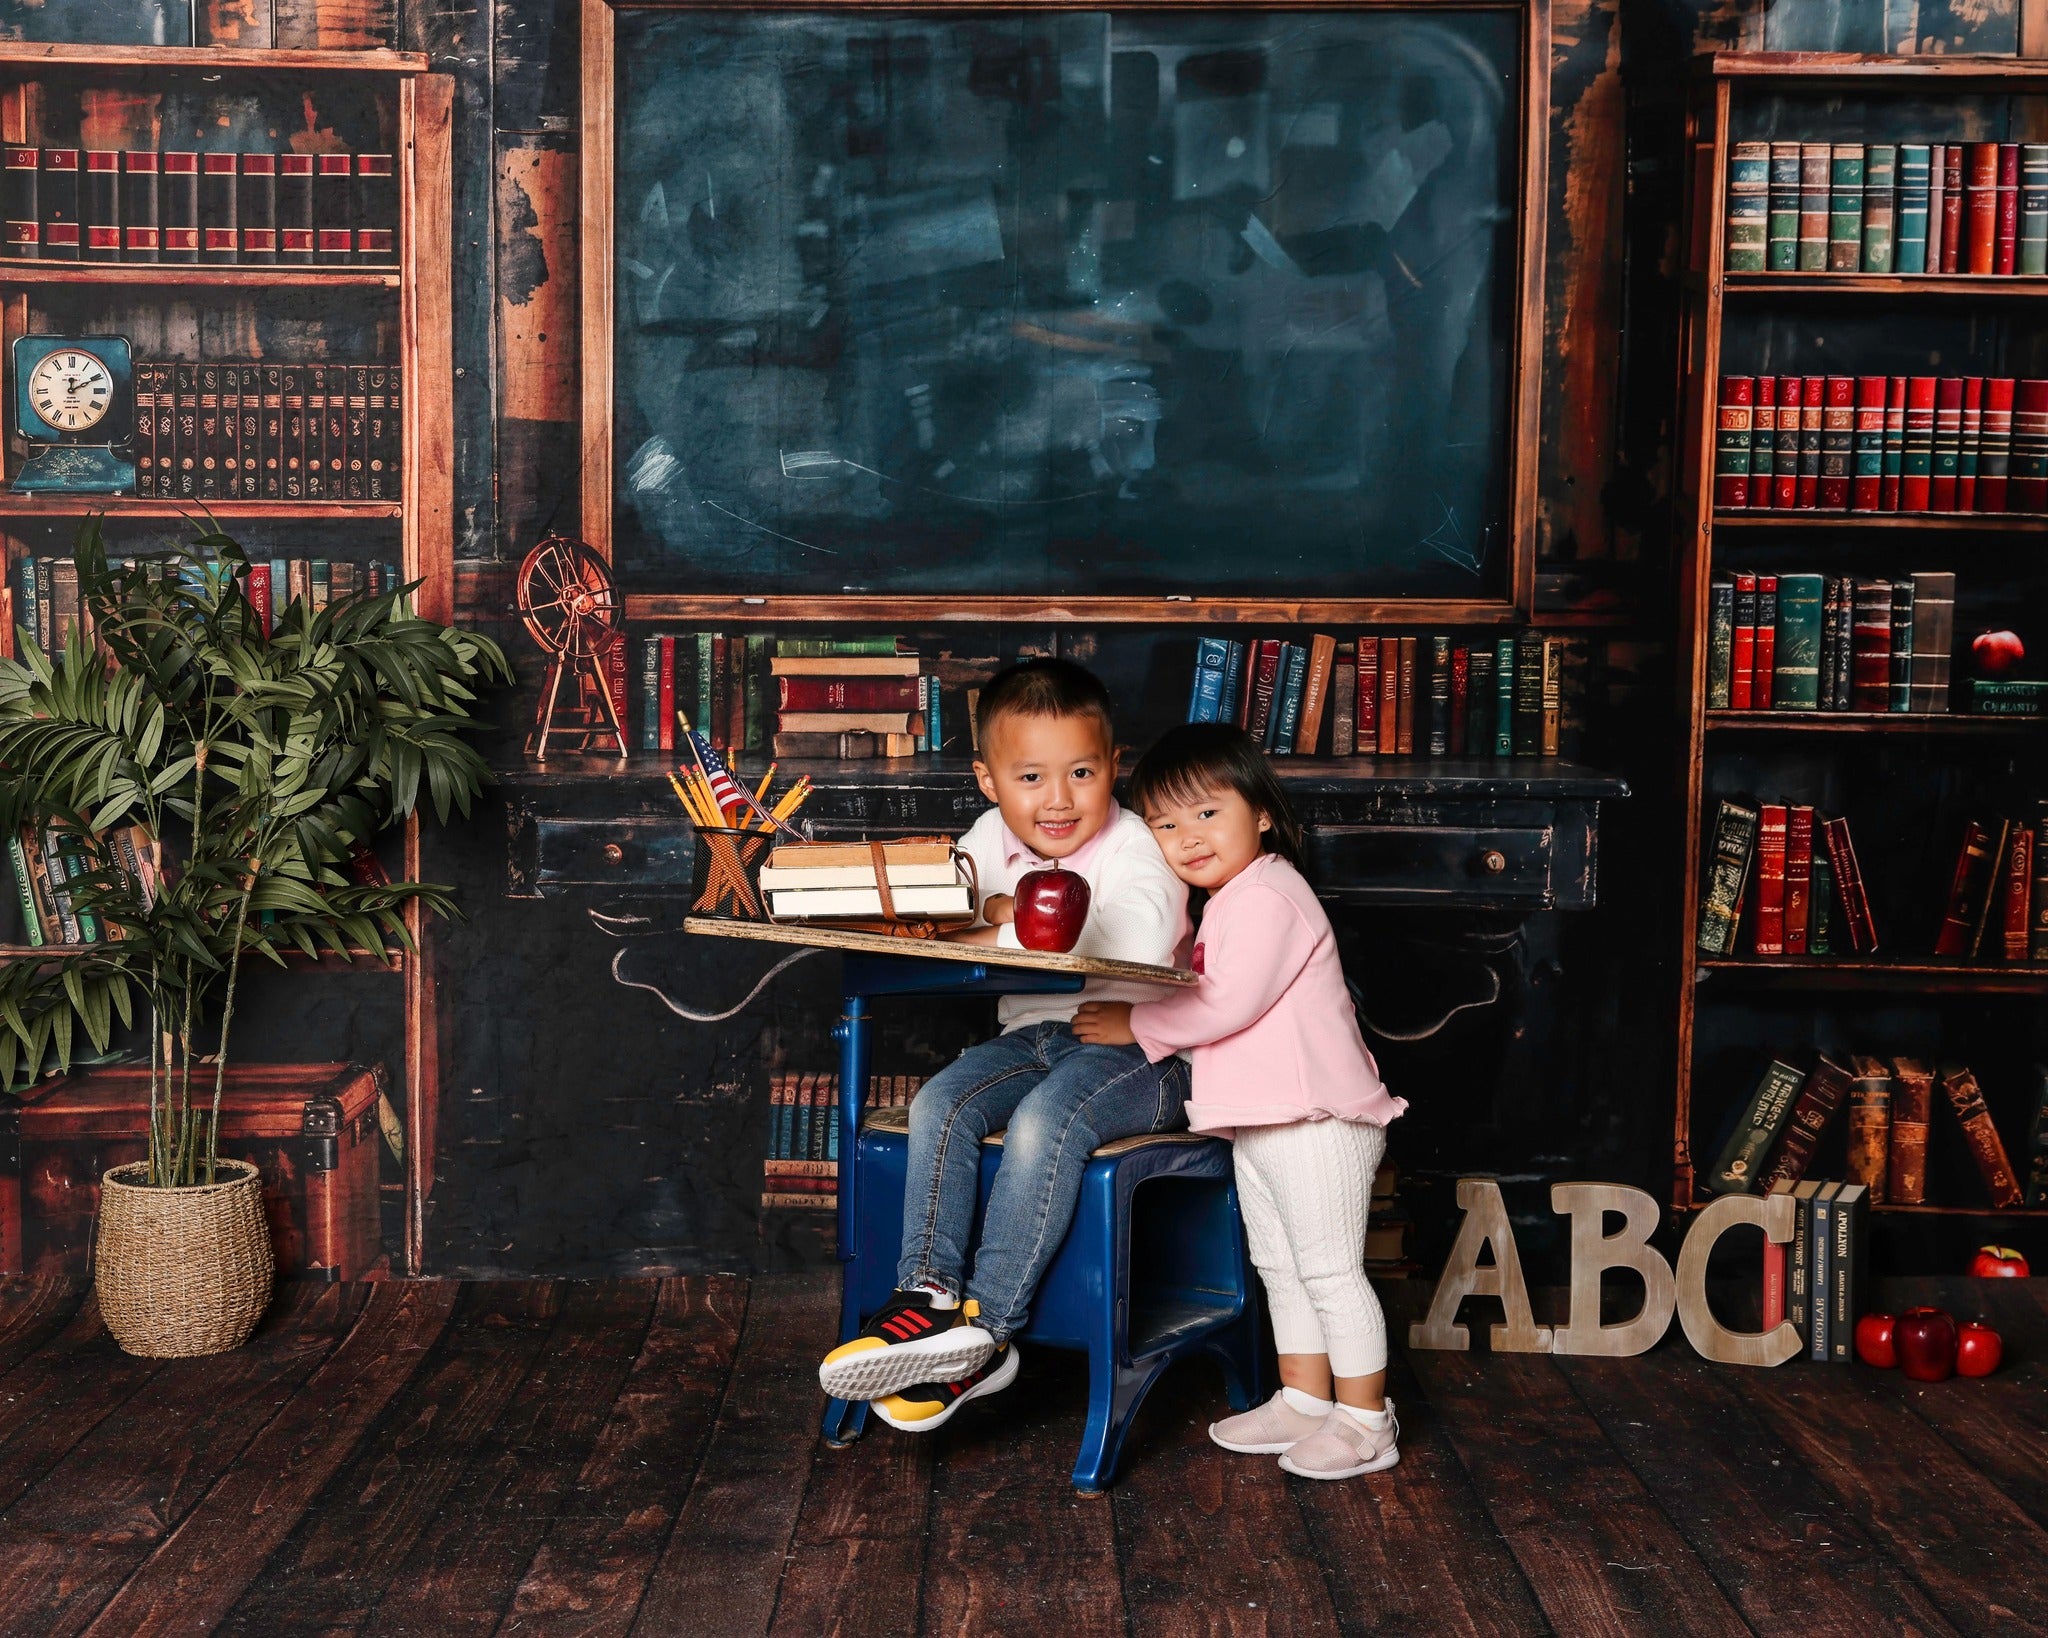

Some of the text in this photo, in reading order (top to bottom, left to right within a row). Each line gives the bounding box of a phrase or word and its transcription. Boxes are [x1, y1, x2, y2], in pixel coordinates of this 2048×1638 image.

[1796, 1230, 1804, 1266] HARVEST
[1838, 1210, 1848, 1258] APOLLYON
[1409, 1178, 1803, 1368] ABC
[1815, 1298, 1825, 1352] NICOLAE
